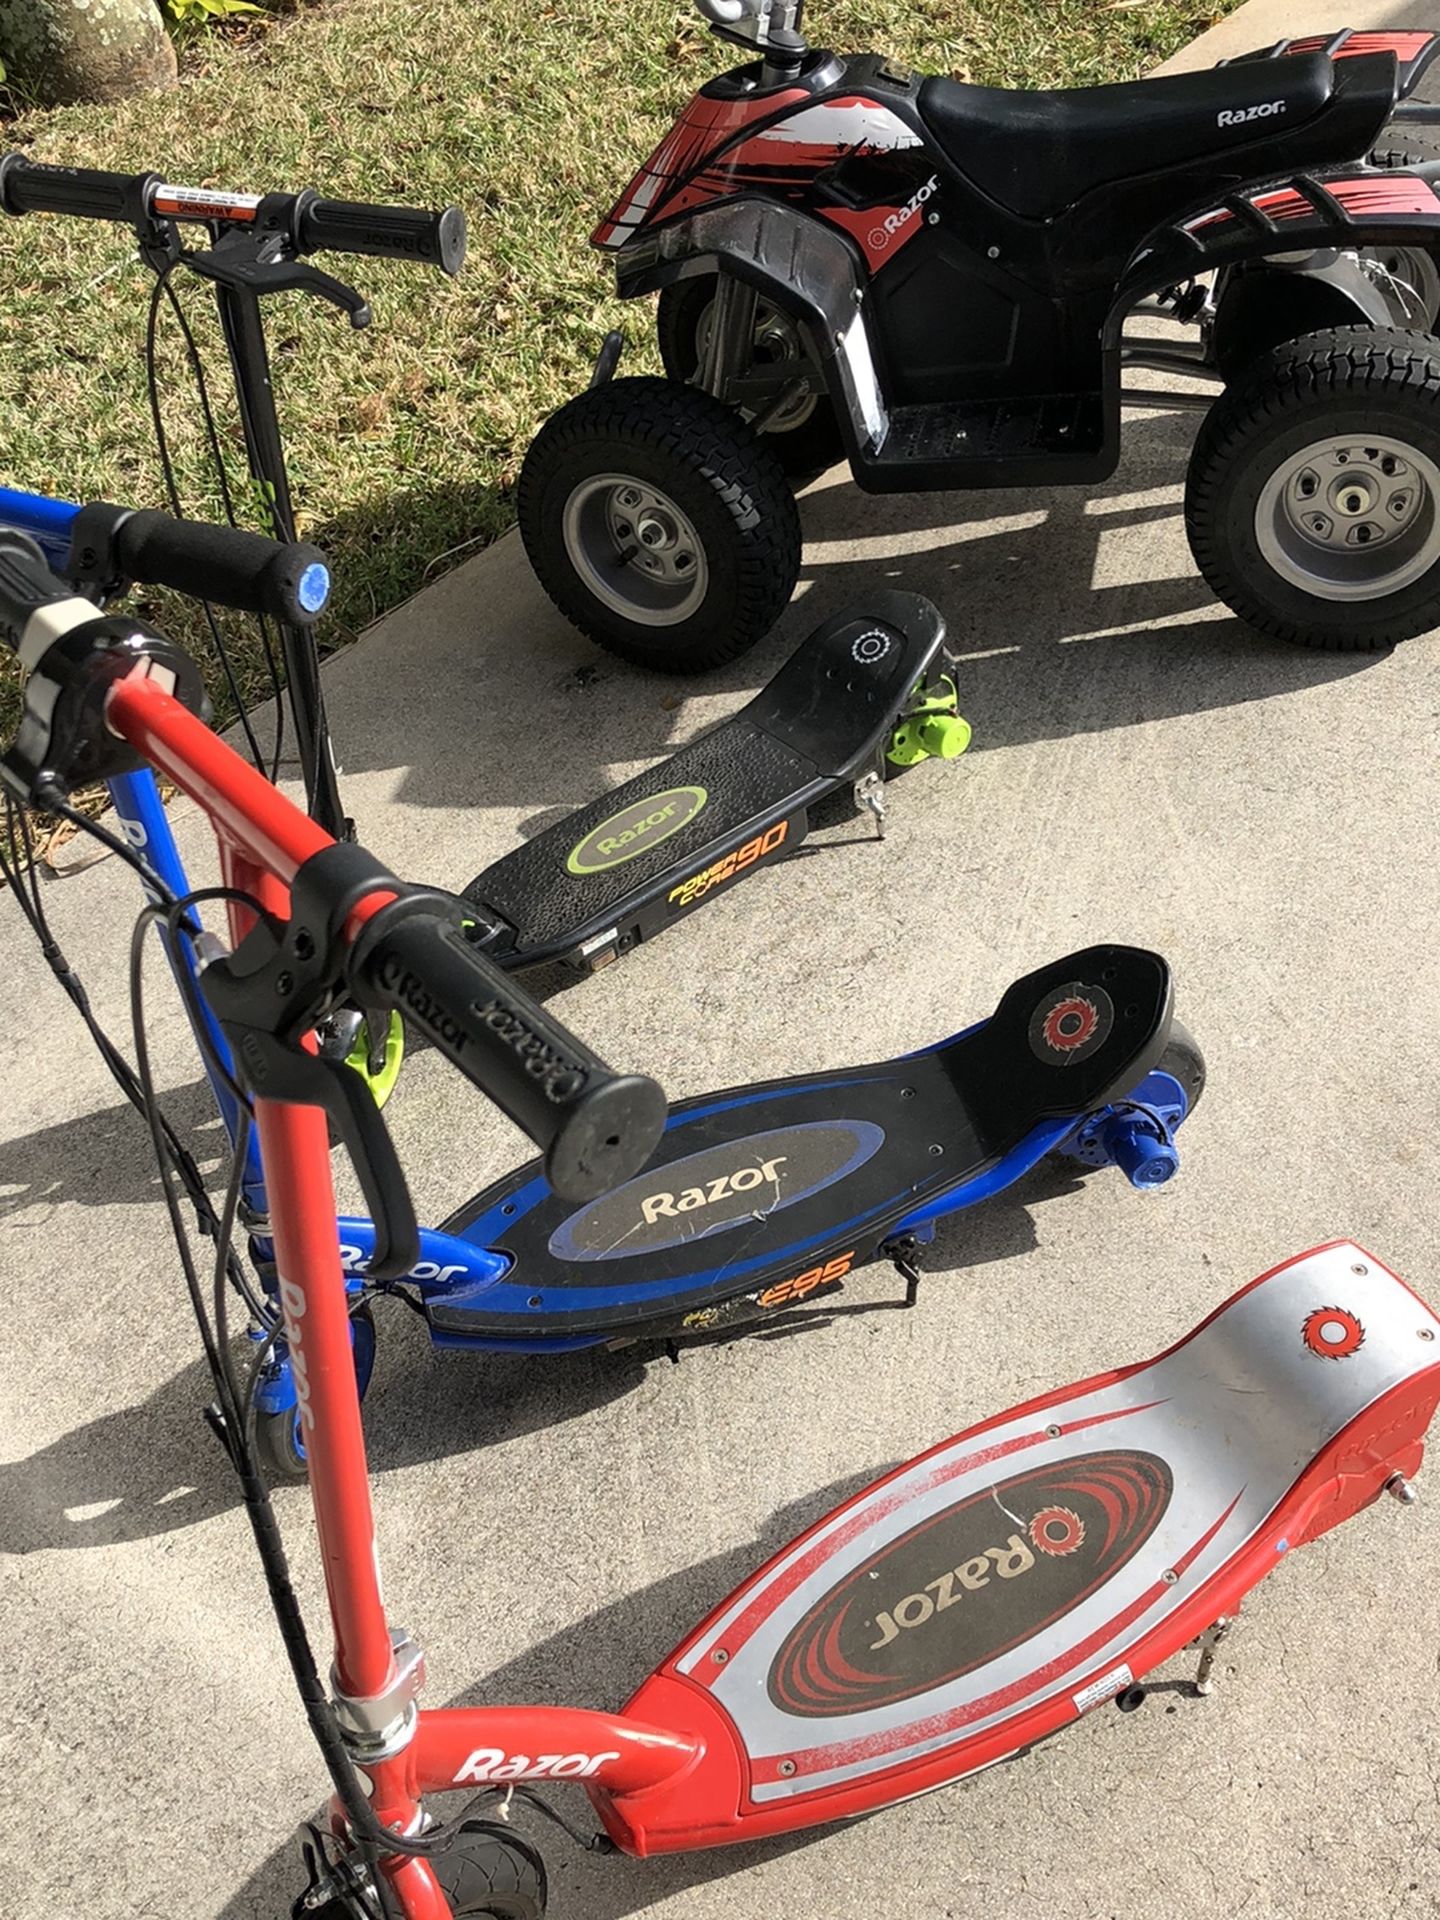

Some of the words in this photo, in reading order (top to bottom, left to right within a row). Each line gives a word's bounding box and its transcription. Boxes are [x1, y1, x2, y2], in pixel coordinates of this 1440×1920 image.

[1217, 100, 1285, 127] Razor
[884, 174, 938, 234] Razor
[596, 801, 677, 856] Razor
[735, 820, 788, 871] 90
[668, 852, 738, 903] POWER
[641, 1156, 787, 1225] Razor
[869, 1533, 1035, 1650] Razor
[452, 1748, 621, 1783] Razor
